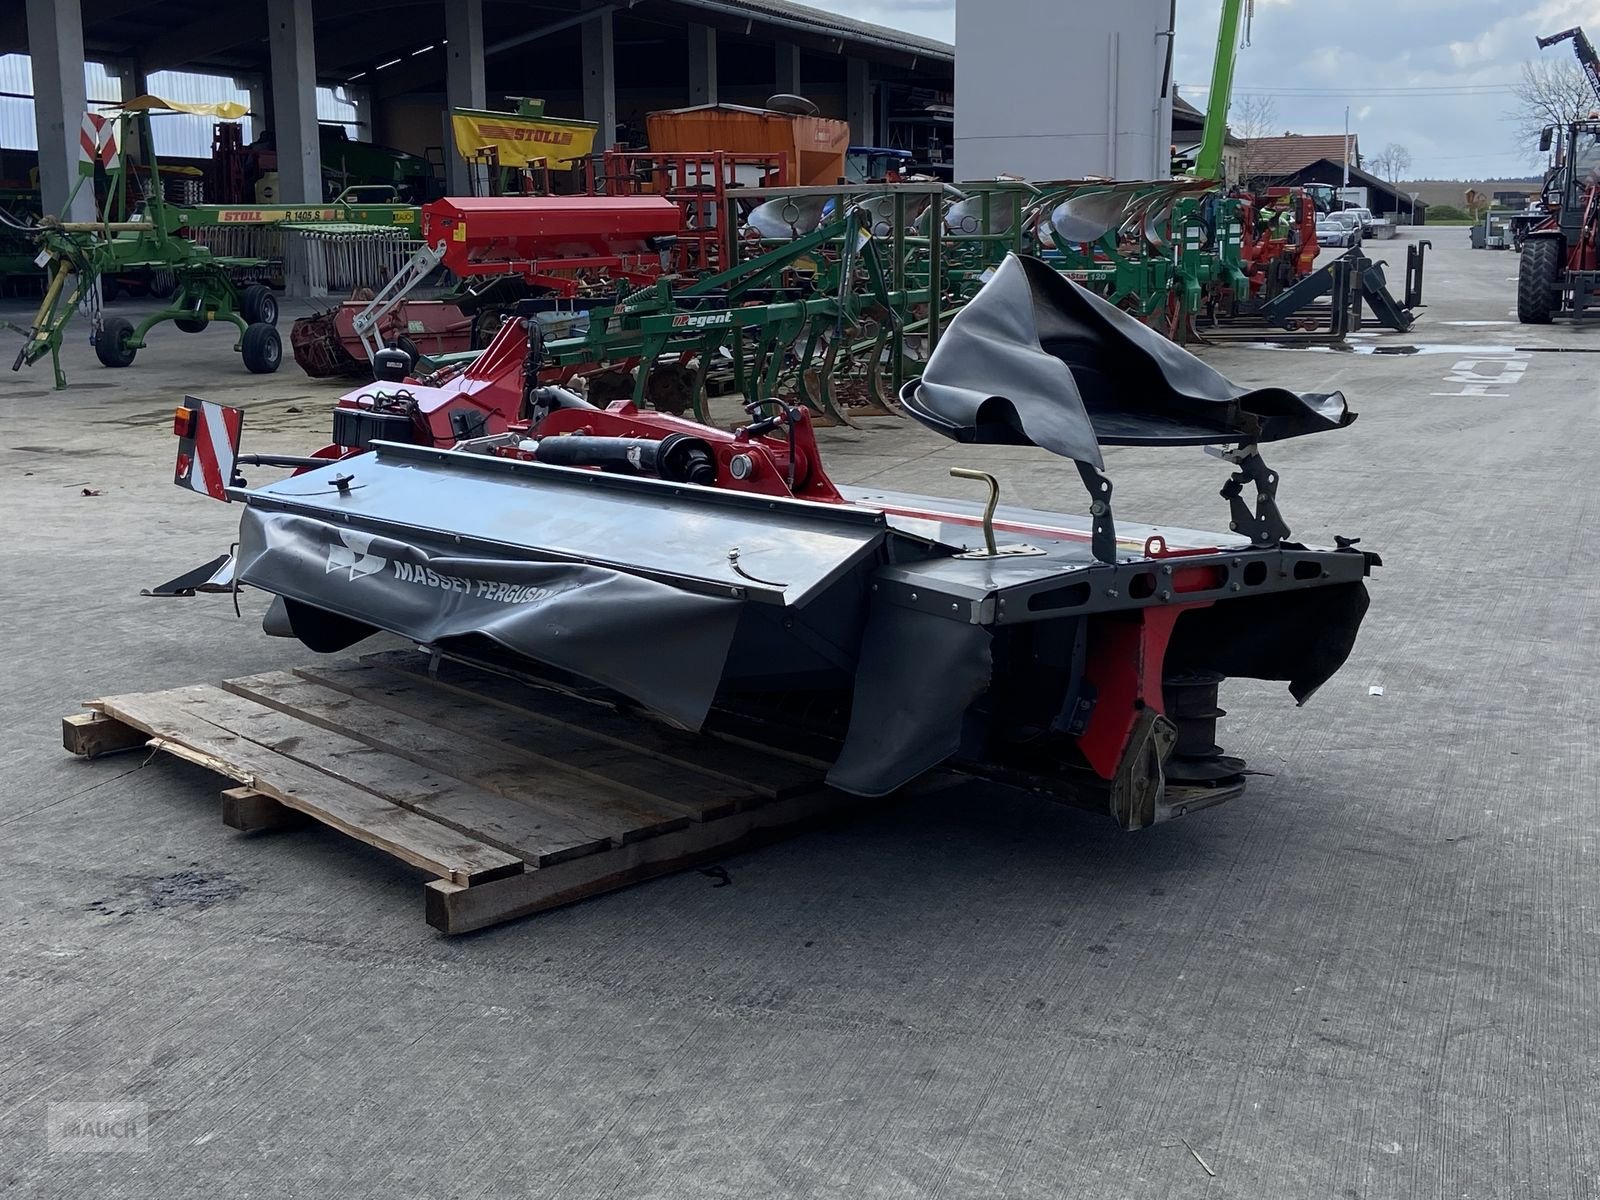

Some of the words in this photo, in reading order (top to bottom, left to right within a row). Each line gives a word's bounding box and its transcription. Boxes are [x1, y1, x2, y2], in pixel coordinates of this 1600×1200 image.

[514, 127, 562, 145] STOLL
[223, 211, 262, 221] STOLL
[285, 211, 292, 220] R
[294, 211, 312, 220] 1405
[314, 210, 321, 220] S
[394, 560, 472, 594] MASSEY
